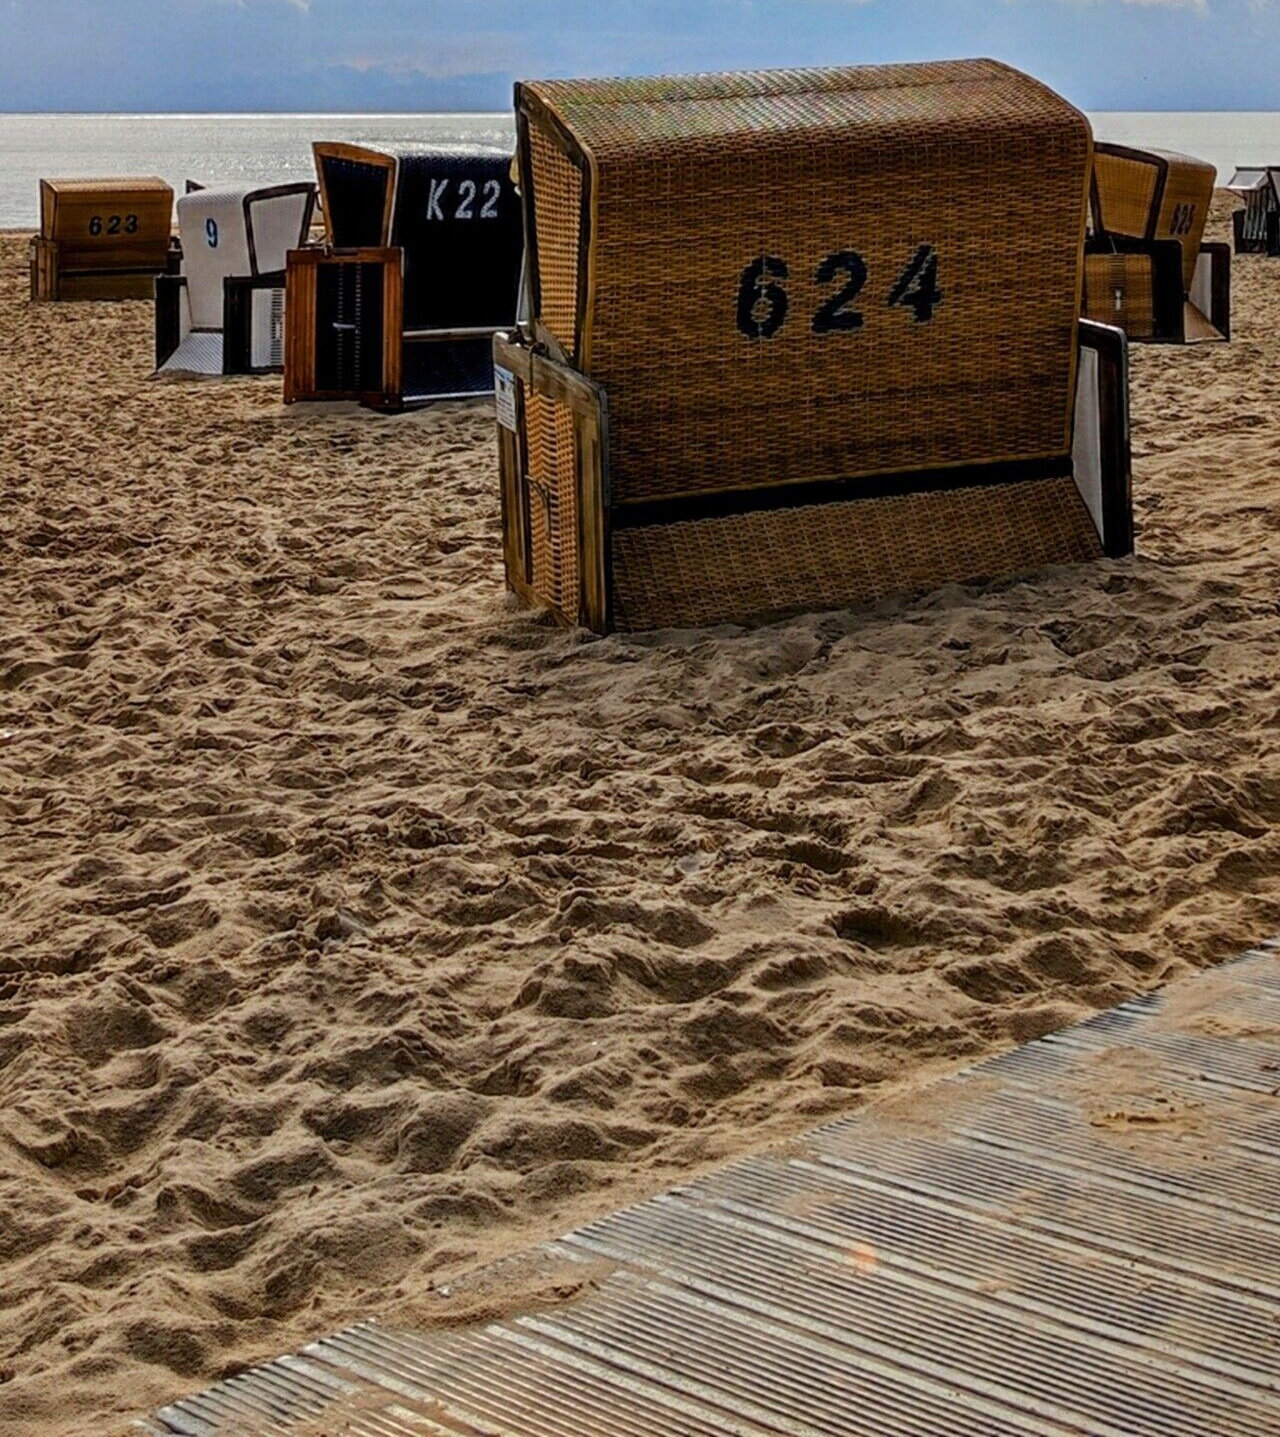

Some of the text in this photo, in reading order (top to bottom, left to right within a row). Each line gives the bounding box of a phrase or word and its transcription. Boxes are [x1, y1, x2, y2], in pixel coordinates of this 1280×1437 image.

[89, 215, 138, 236] 623
[206, 218, 218, 248] 9
[736, 245, 942, 338] 624
